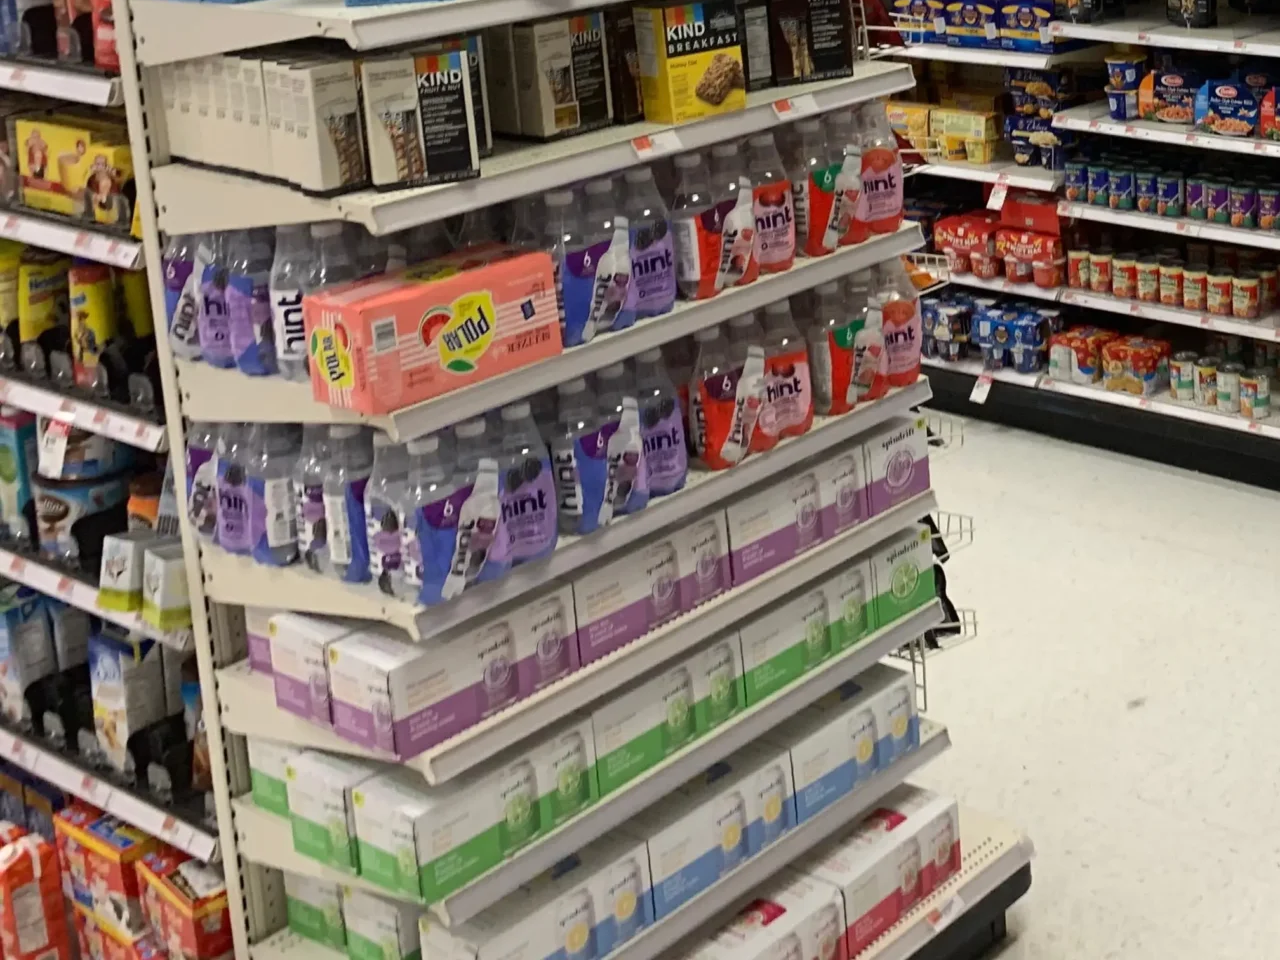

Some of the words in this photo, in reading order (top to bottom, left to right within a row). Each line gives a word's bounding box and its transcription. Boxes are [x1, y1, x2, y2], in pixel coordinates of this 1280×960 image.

[666, 22, 705, 41] KIND
[667, 32, 739, 54] BREAKFAST
[417, 70, 462, 87] KIND
[824, 173, 832, 184] 6
[754, 205, 792, 233] hint
[583, 251, 592, 268] 6
[631, 248, 673, 278] hint
[443, 304, 491, 352] POLAR
[722, 375, 731, 391] 6
[766, 379, 803, 402] hint
[882, 427, 915, 451] spindrift
[444, 500, 453, 517] 6
[501, 488, 548, 518] hint
[886, 540, 919, 564] spindrift
